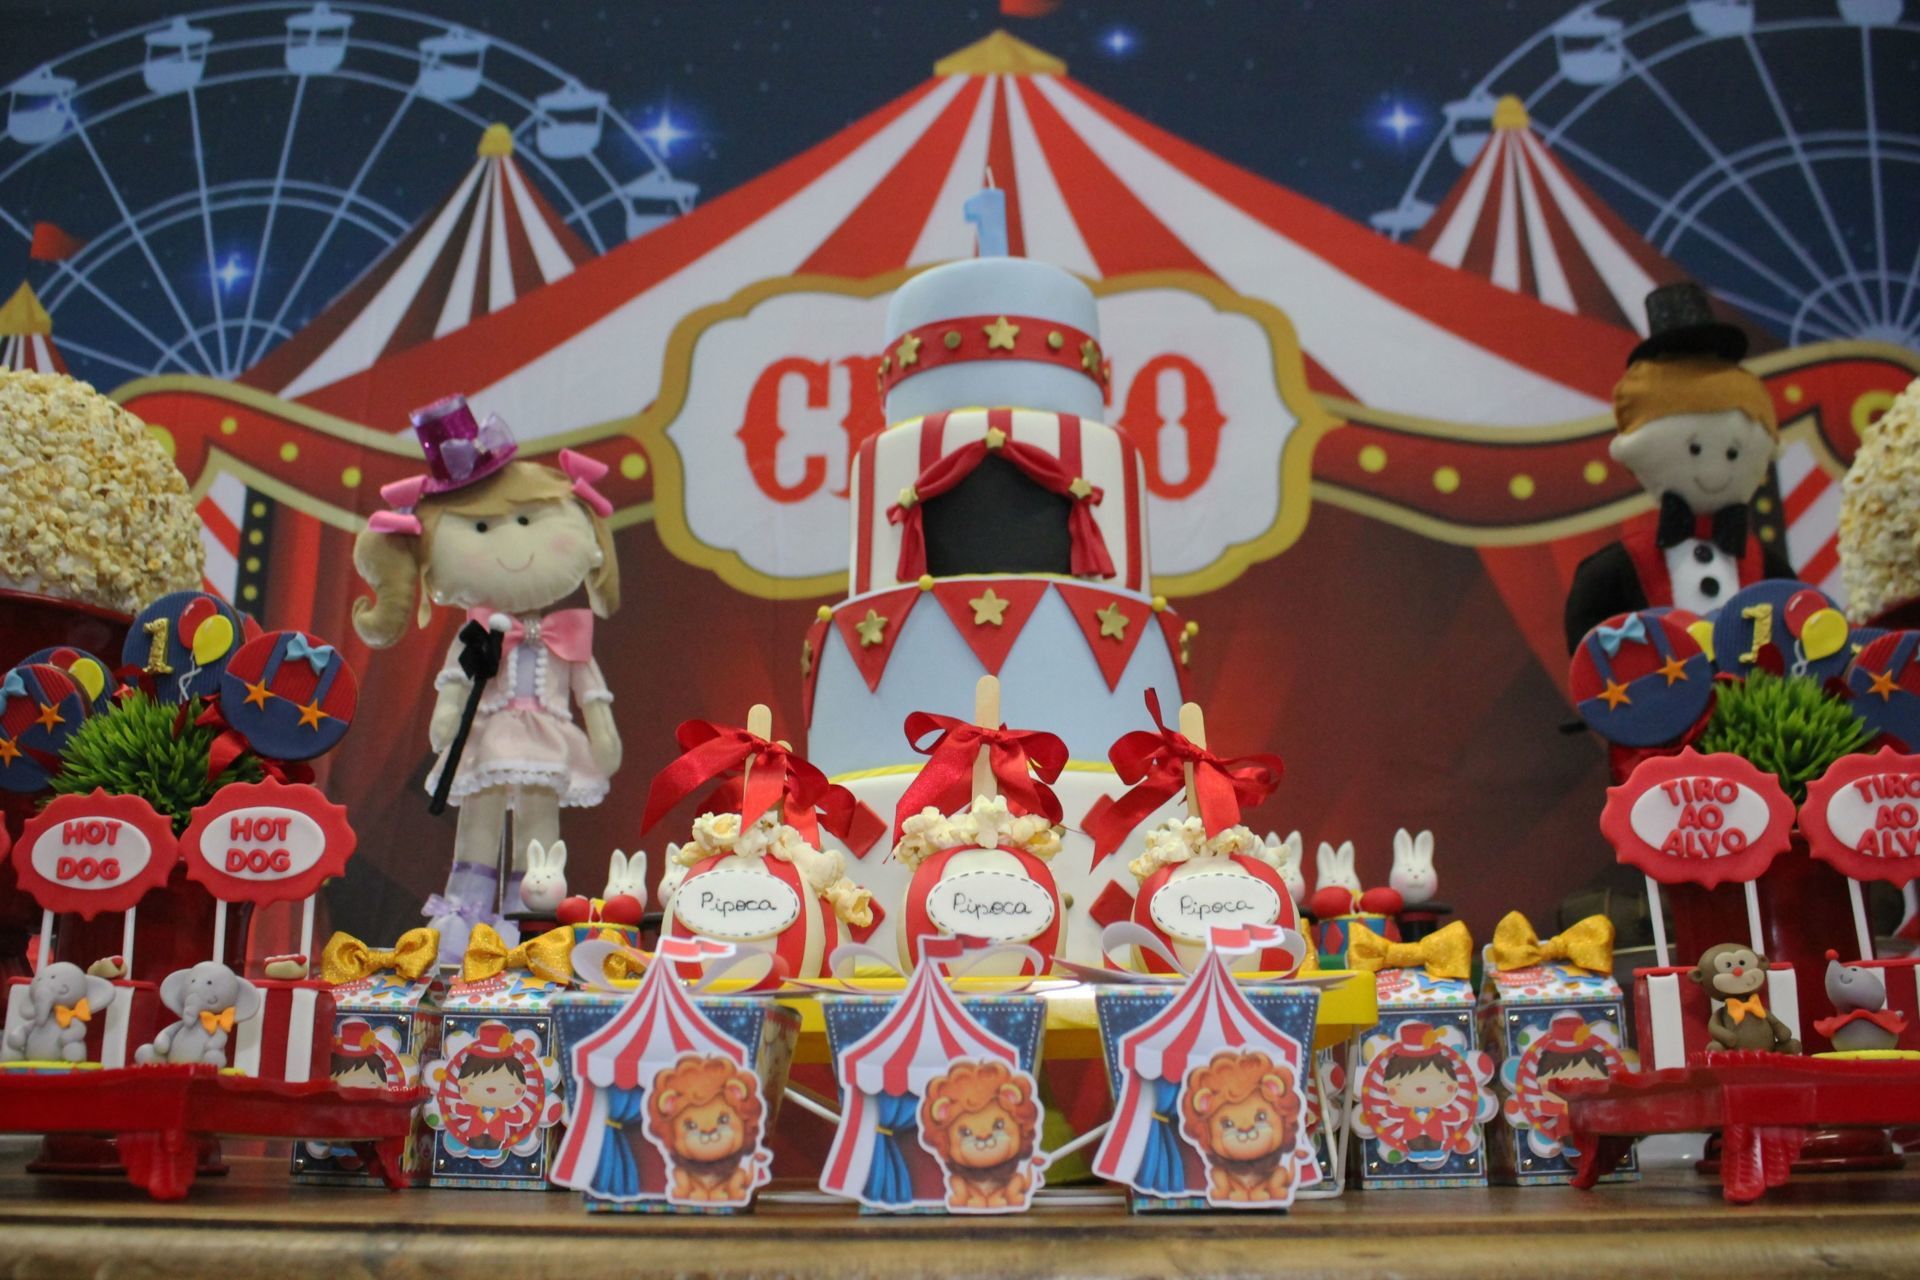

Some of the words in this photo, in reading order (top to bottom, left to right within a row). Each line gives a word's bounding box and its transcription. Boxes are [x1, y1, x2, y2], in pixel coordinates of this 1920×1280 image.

[963, 187, 1008, 258] 1
[735, 351, 1229, 504] CIO
[143, 617, 174, 674] 1
[1739, 603, 1773, 664] 1
[1661, 777, 1739, 806] TIRO
[229, 817, 291, 842] HOT
[1678, 803, 1724, 831] AO
[1876, 802, 1919, 830] AO
[62, 821, 122, 846] HOT
[1661, 827, 1748, 860] ALVO
[1856, 828, 1920, 859] ALV
[56, 857, 121, 881] DOG
[225, 849, 291, 873] DOG
[701, 891, 777, 918] Pipoca
[953, 892, 1032, 920] Pipoca
[1180, 894, 1255, 920] Pipoca
